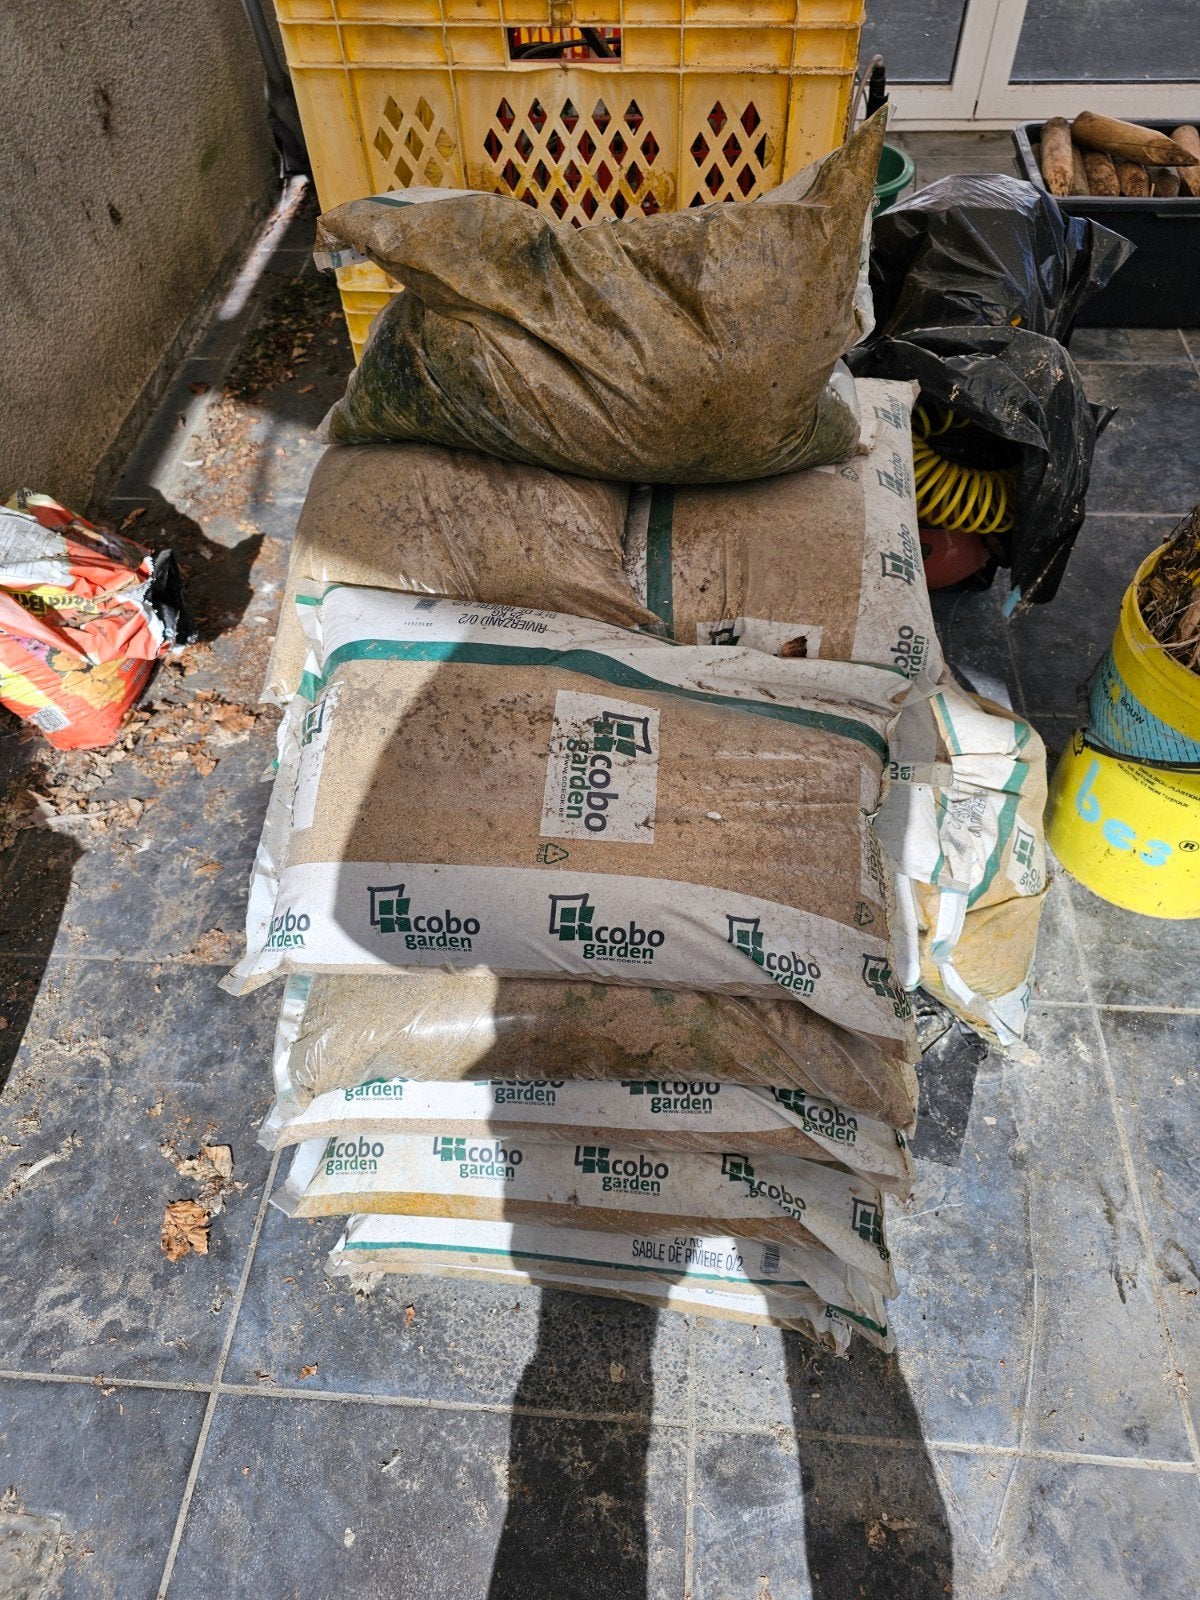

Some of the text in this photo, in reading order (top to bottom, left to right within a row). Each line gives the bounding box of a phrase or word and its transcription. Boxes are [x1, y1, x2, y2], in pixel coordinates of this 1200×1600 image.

[897, 523, 913, 558] cobo
[459, 613, 547, 633] RIVIERZAND 0/2
[491, 609, 507, 617] KG
[890, 625, 914, 668] obo
[907, 634, 925, 676] rden
[1120, 697, 1144, 724] BOUW
[566, 738, 592, 819] garden
[584, 754, 619, 832] cobo
[413, 909, 481, 935] cobo
[594, 920, 665, 947] cobo
[265, 930, 306, 947] rden
[404, 931, 472, 950] garden
[582, 941, 655, 960] garden
[766, 950, 822, 979] cobo
[766, 970, 815, 993] rden
[344, 1083, 404, 1101] garden
[494, 1084, 556, 1104] garden
[650, 1093, 713, 1114] garden
[802, 1118, 857, 1142] garden
[806, 1105, 859, 1131] cobo
[335, 1135, 385, 1158] cobo
[468, 1141, 523, 1165] cobo
[325, 1154, 378, 1176] garden
[459, 1161, 515, 1179] garden
[611, 1154, 669, 1179] cobo
[601, 1174, 661, 1192] garden
[756, 1180, 807, 1211] cobo
[632, 1239, 744, 1272] SABLE DE RIVIERE 0/2
